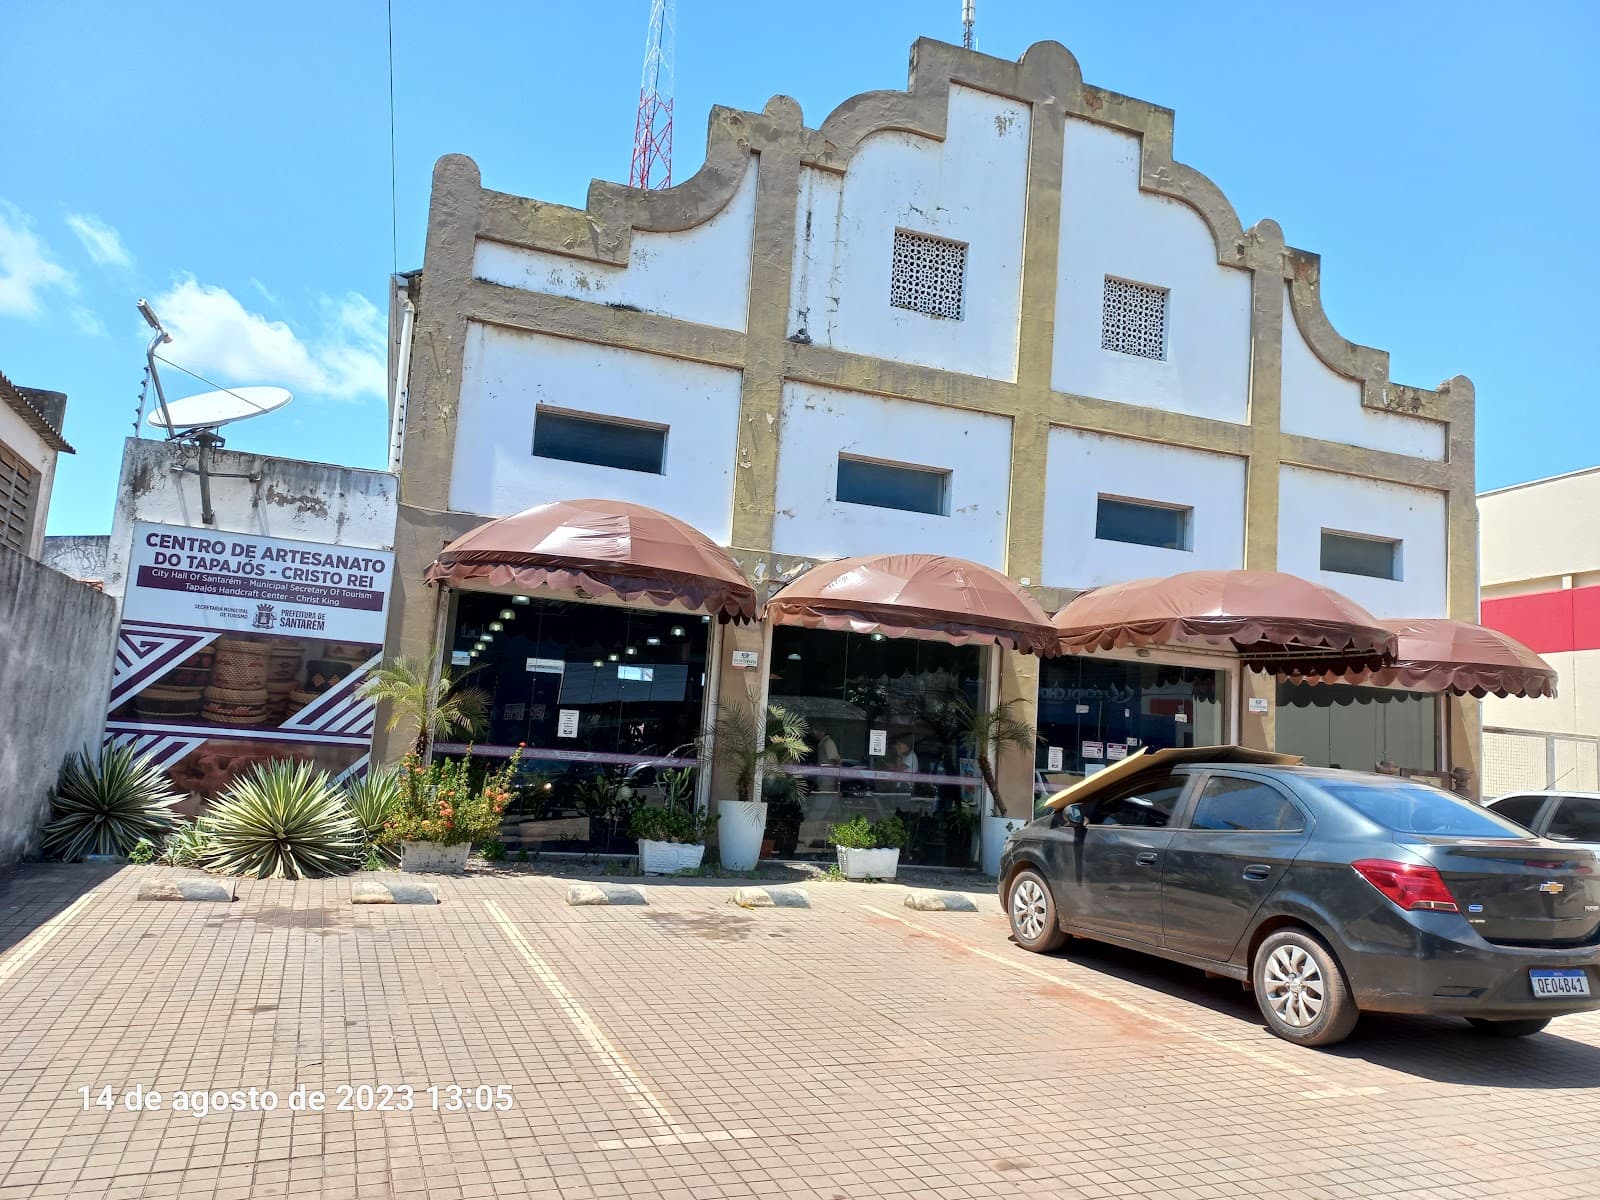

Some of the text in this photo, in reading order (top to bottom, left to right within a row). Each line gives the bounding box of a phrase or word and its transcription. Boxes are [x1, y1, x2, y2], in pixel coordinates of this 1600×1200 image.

[146, 532, 386, 573] CENTRO DE ARTESANATO
[152, 568, 169, 579] City
[171, 570, 188, 580] Hall
[190, 572, 200, 581] Of
[249, 580, 288, 591] Municipal
[290, 584, 328, 596] Secretary
[330, 588, 340, 596] Of
[342, 589, 372, 599] Tourism
[154, 551, 182, 567] DO
[187, 555, 265, 576] TAPAJÓS
[282, 566, 343, 586] CRISTO
[347, 573, 374, 589] REI
[185, 582, 217, 593] Tapajós
[219, 587, 259, 598] Handcraft
[261, 590, 288, 600] Center
[296, 594, 320, 604] Christ
[321, 597, 340, 606] King
[281, 609, 326, 620] PREFEITURA DE
